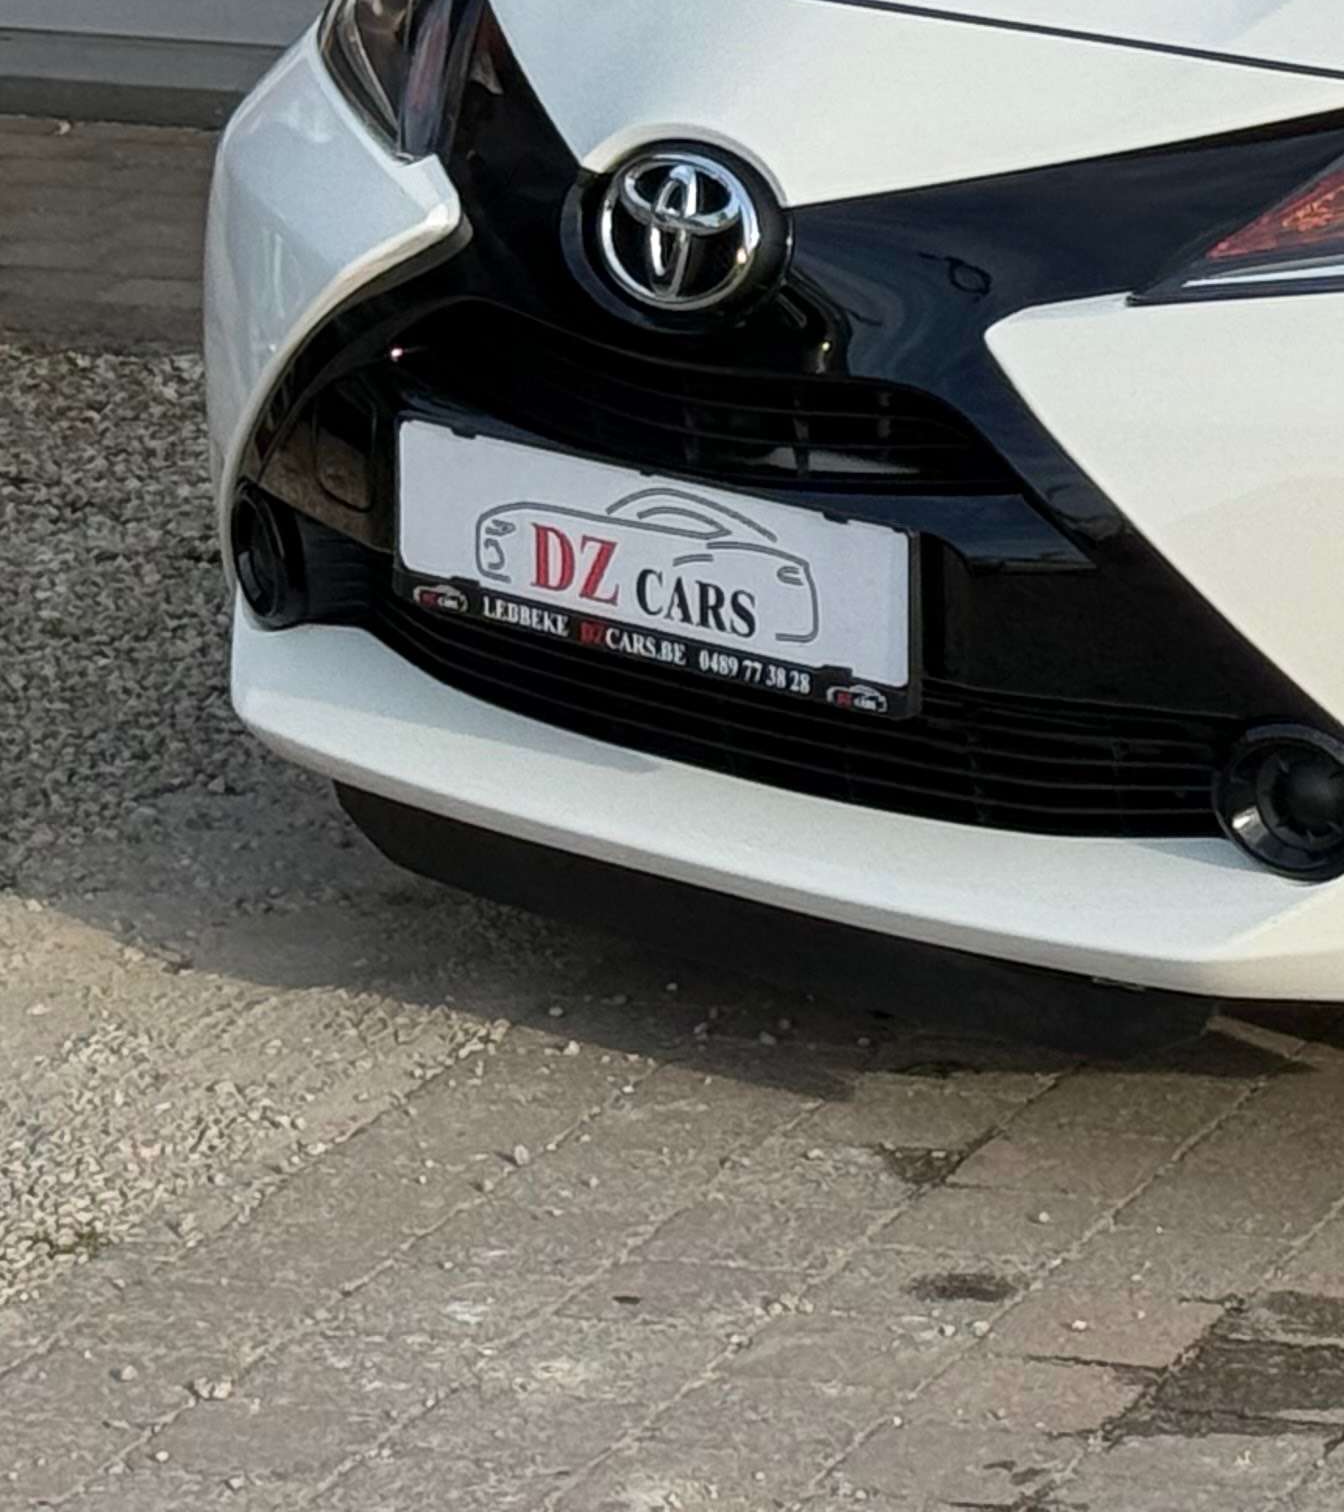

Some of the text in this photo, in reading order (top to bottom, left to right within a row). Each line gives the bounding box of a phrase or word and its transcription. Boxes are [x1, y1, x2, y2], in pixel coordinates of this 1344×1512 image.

[530, 522, 756, 638] DZ CARS
[483, 596, 569, 637] LEBBEKE
[699, 649, 738, 677] 0489
[742, 659, 763, 683] 77
[765, 664, 786, 688] 38
[789, 670, 811, 694] 28
